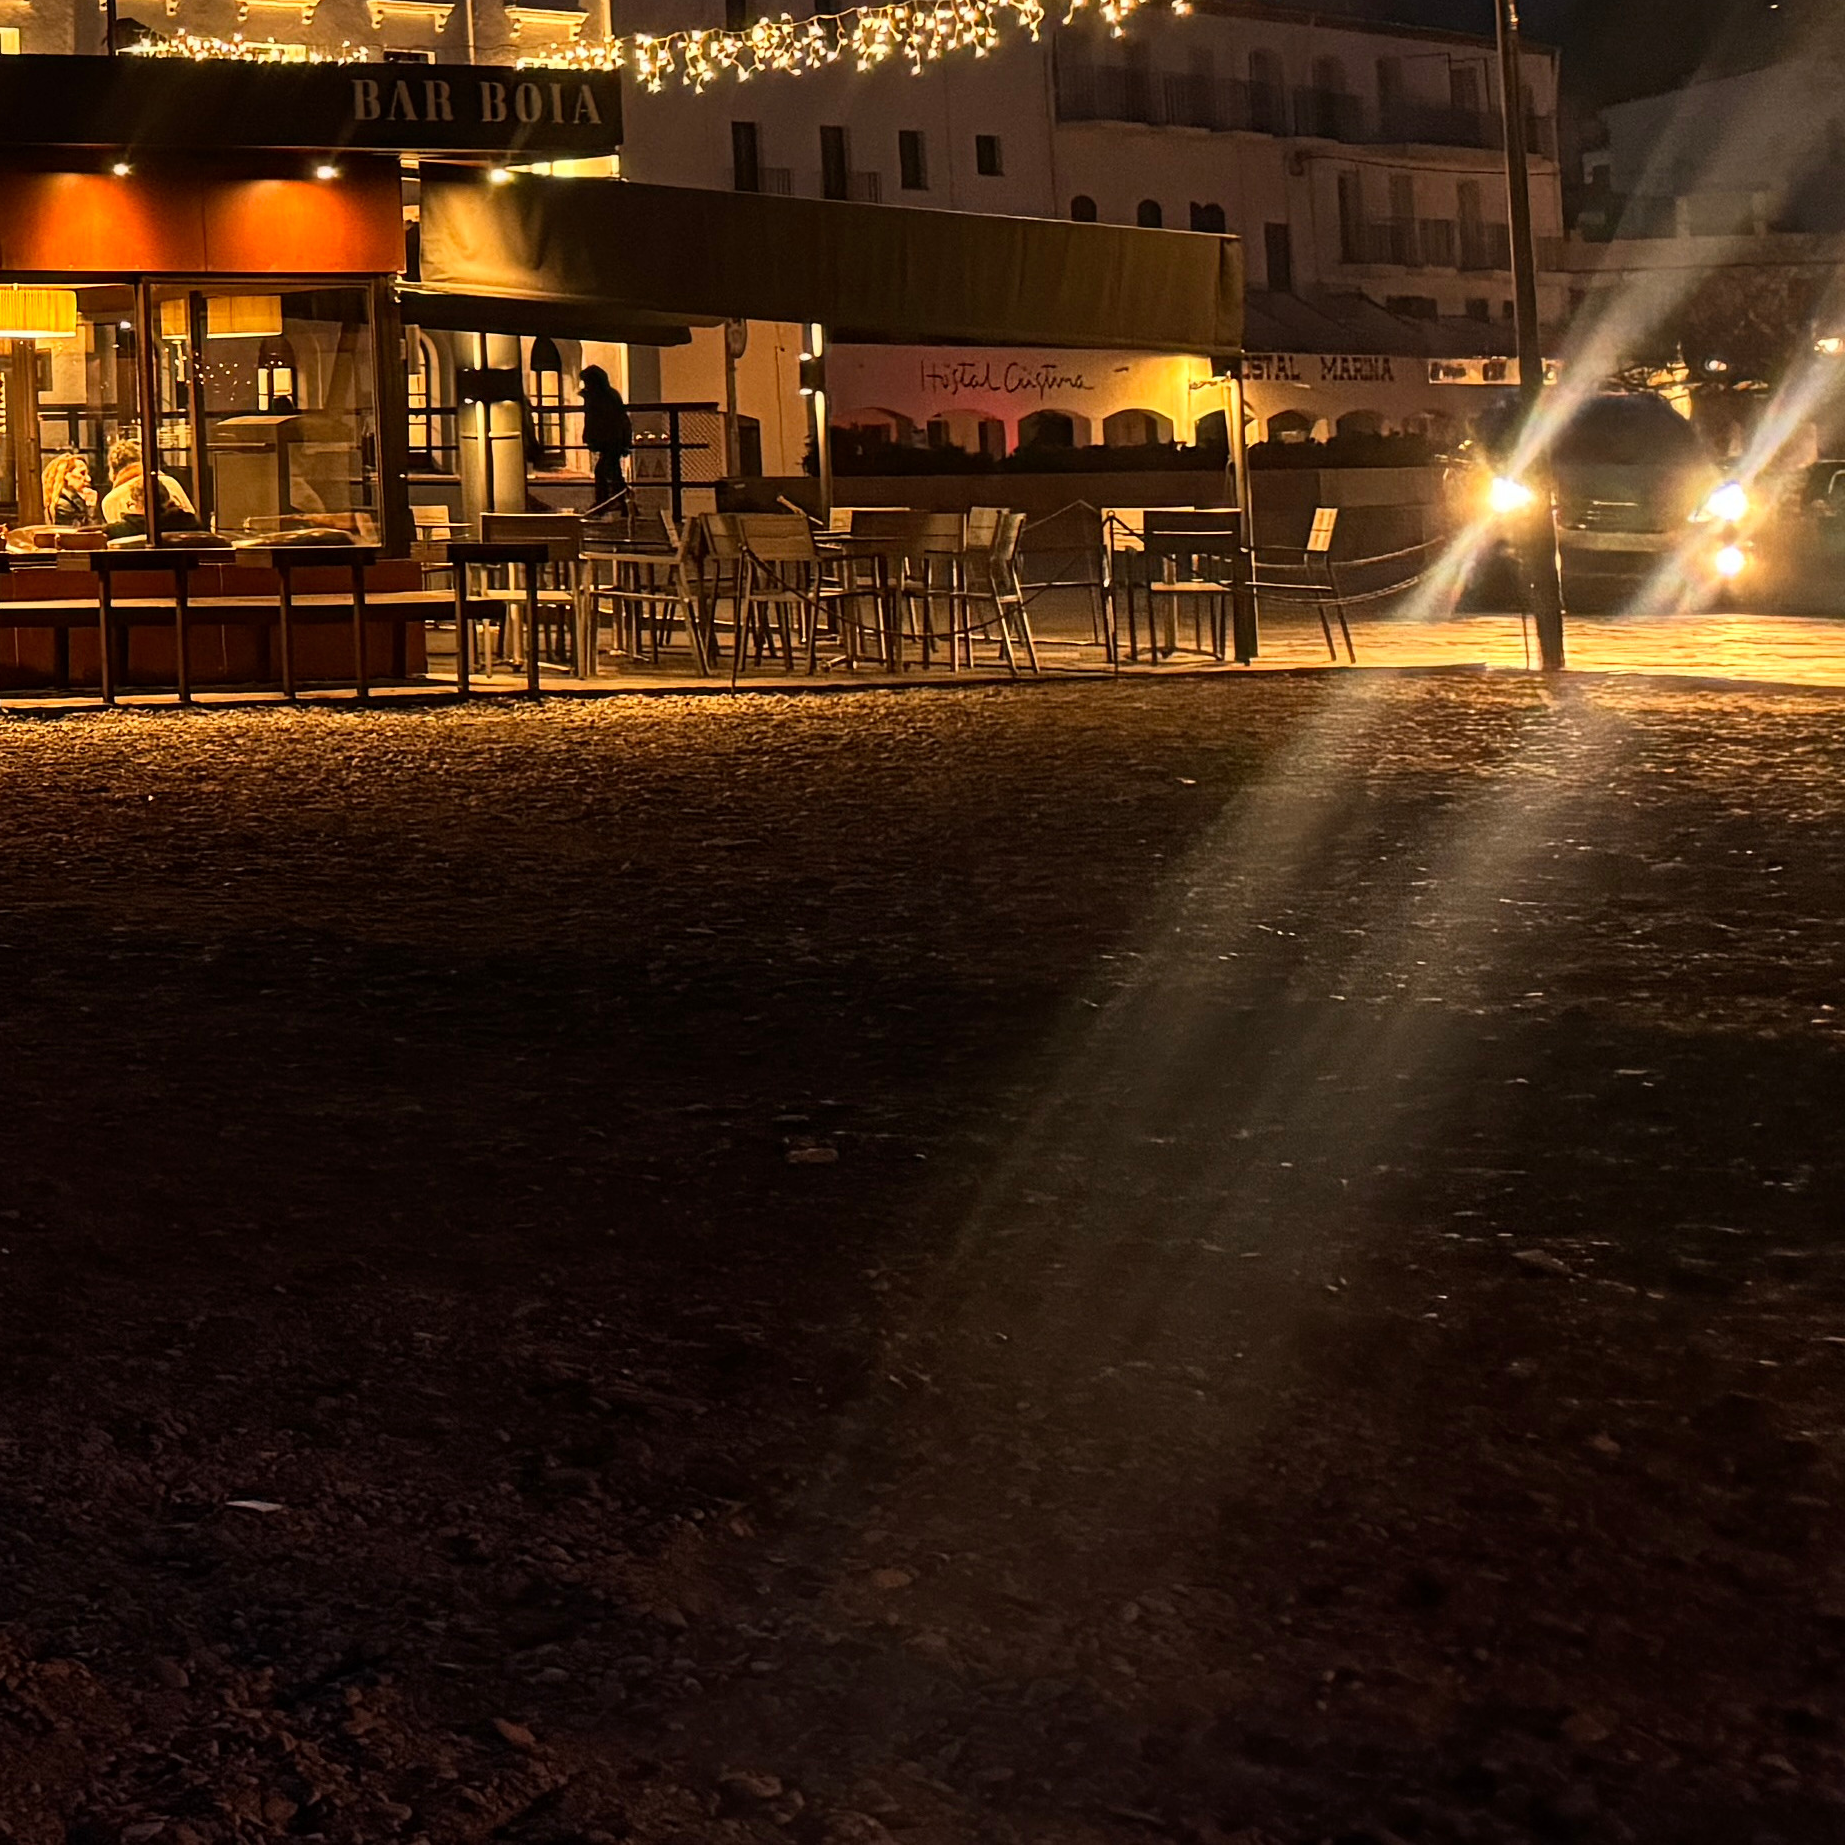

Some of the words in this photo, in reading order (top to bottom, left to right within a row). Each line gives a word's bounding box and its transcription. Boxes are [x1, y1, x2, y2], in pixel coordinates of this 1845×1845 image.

[351, 79, 454, 122] BAR
[480, 81, 603, 125] BOIA
[921, 360, 1001, 395] Hostal
[1319, 356, 1395, 382] MARINA
